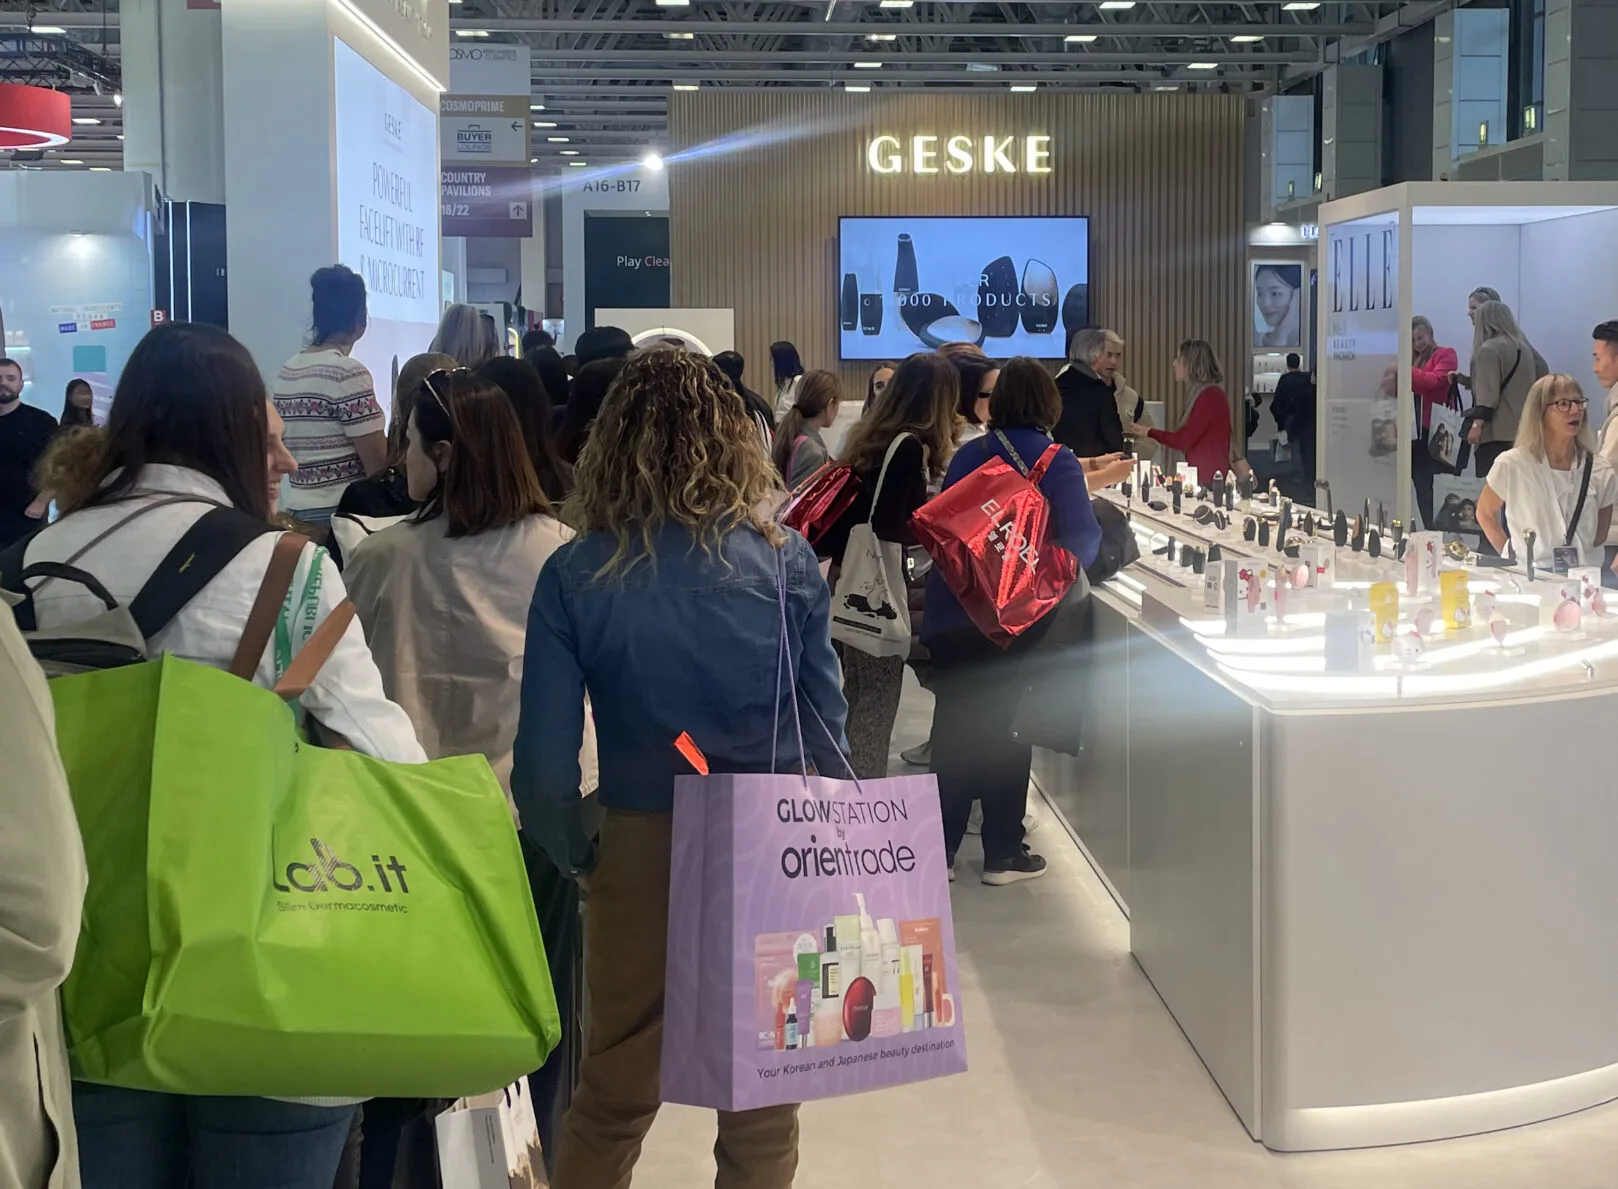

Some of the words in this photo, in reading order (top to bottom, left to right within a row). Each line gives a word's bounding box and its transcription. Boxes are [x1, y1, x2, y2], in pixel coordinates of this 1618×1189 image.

[440, 100, 505, 112] COSMOPRIME
[457, 132, 492, 141] BUYER
[868, 135, 1052, 173] GESKE
[373, 162, 413, 212] POWERFUL
[441, 172, 486, 183] COUNTRY
[583, 180, 641, 193] A16-B17
[441, 185, 492, 197] PAVILIONS
[360, 204, 394, 250] FACELIFT
[394, 219, 414, 256] WITH
[617, 256, 642, 269] Play
[1333, 229, 1393, 313] ELLE
[367, 256, 424, 300] MICROCURRENT
[777, 798, 909, 824] GLOWSTATION
[836, 826, 846, 840] by
[781, 834, 916, 879] orientrade
[308, 901, 409, 914] Dermacosmetic
[756, 1067, 780, 1080] Your
[783, 1062, 816, 1076] Korean
[818, 1057, 836, 1069] and
[836, 1052, 878, 1067] Japanese
[880, 1046, 910, 1061] beauty
[911, 1039, 956, 1055] destination
